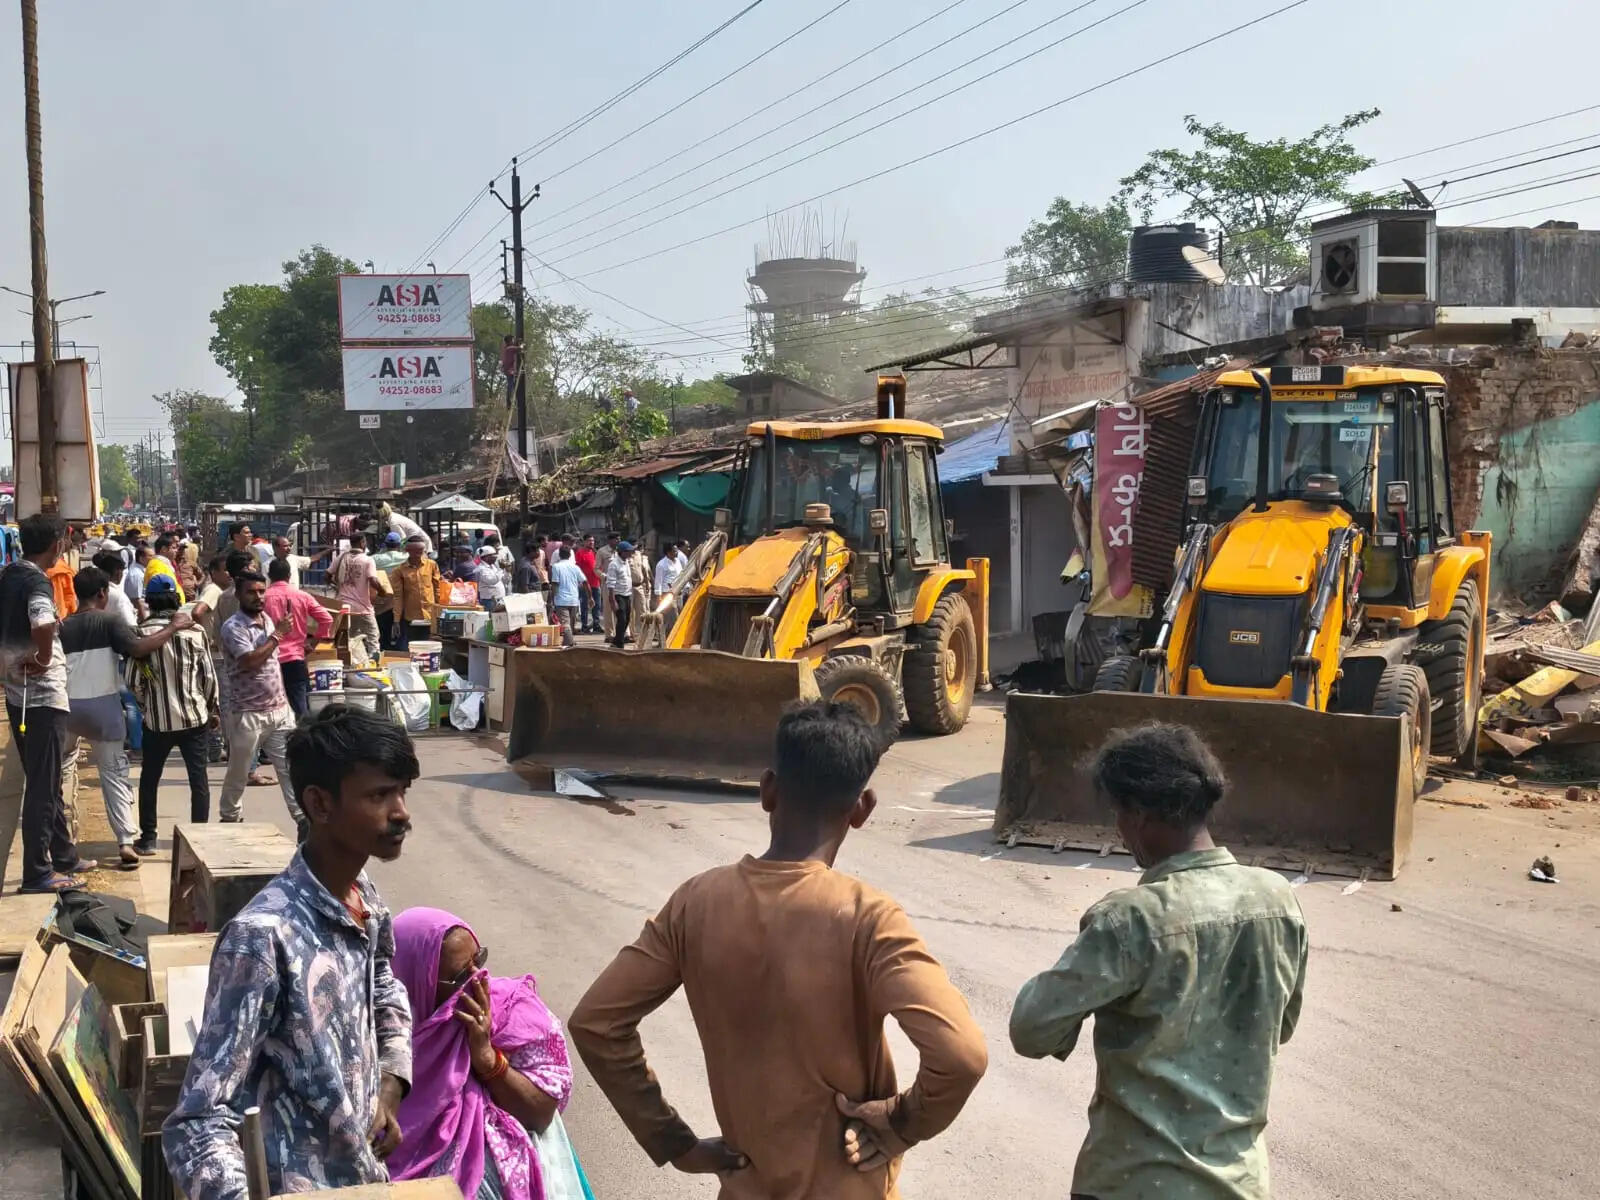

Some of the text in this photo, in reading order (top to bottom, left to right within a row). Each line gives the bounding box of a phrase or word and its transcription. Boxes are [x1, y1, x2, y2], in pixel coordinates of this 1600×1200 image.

[377, 284, 440, 306] ASA
[377, 314, 441, 323] 94252-08683
[379, 356, 441, 378] ASA
[379, 386, 442, 395] 94252-08683
[1232, 633, 1257, 641] JCB
